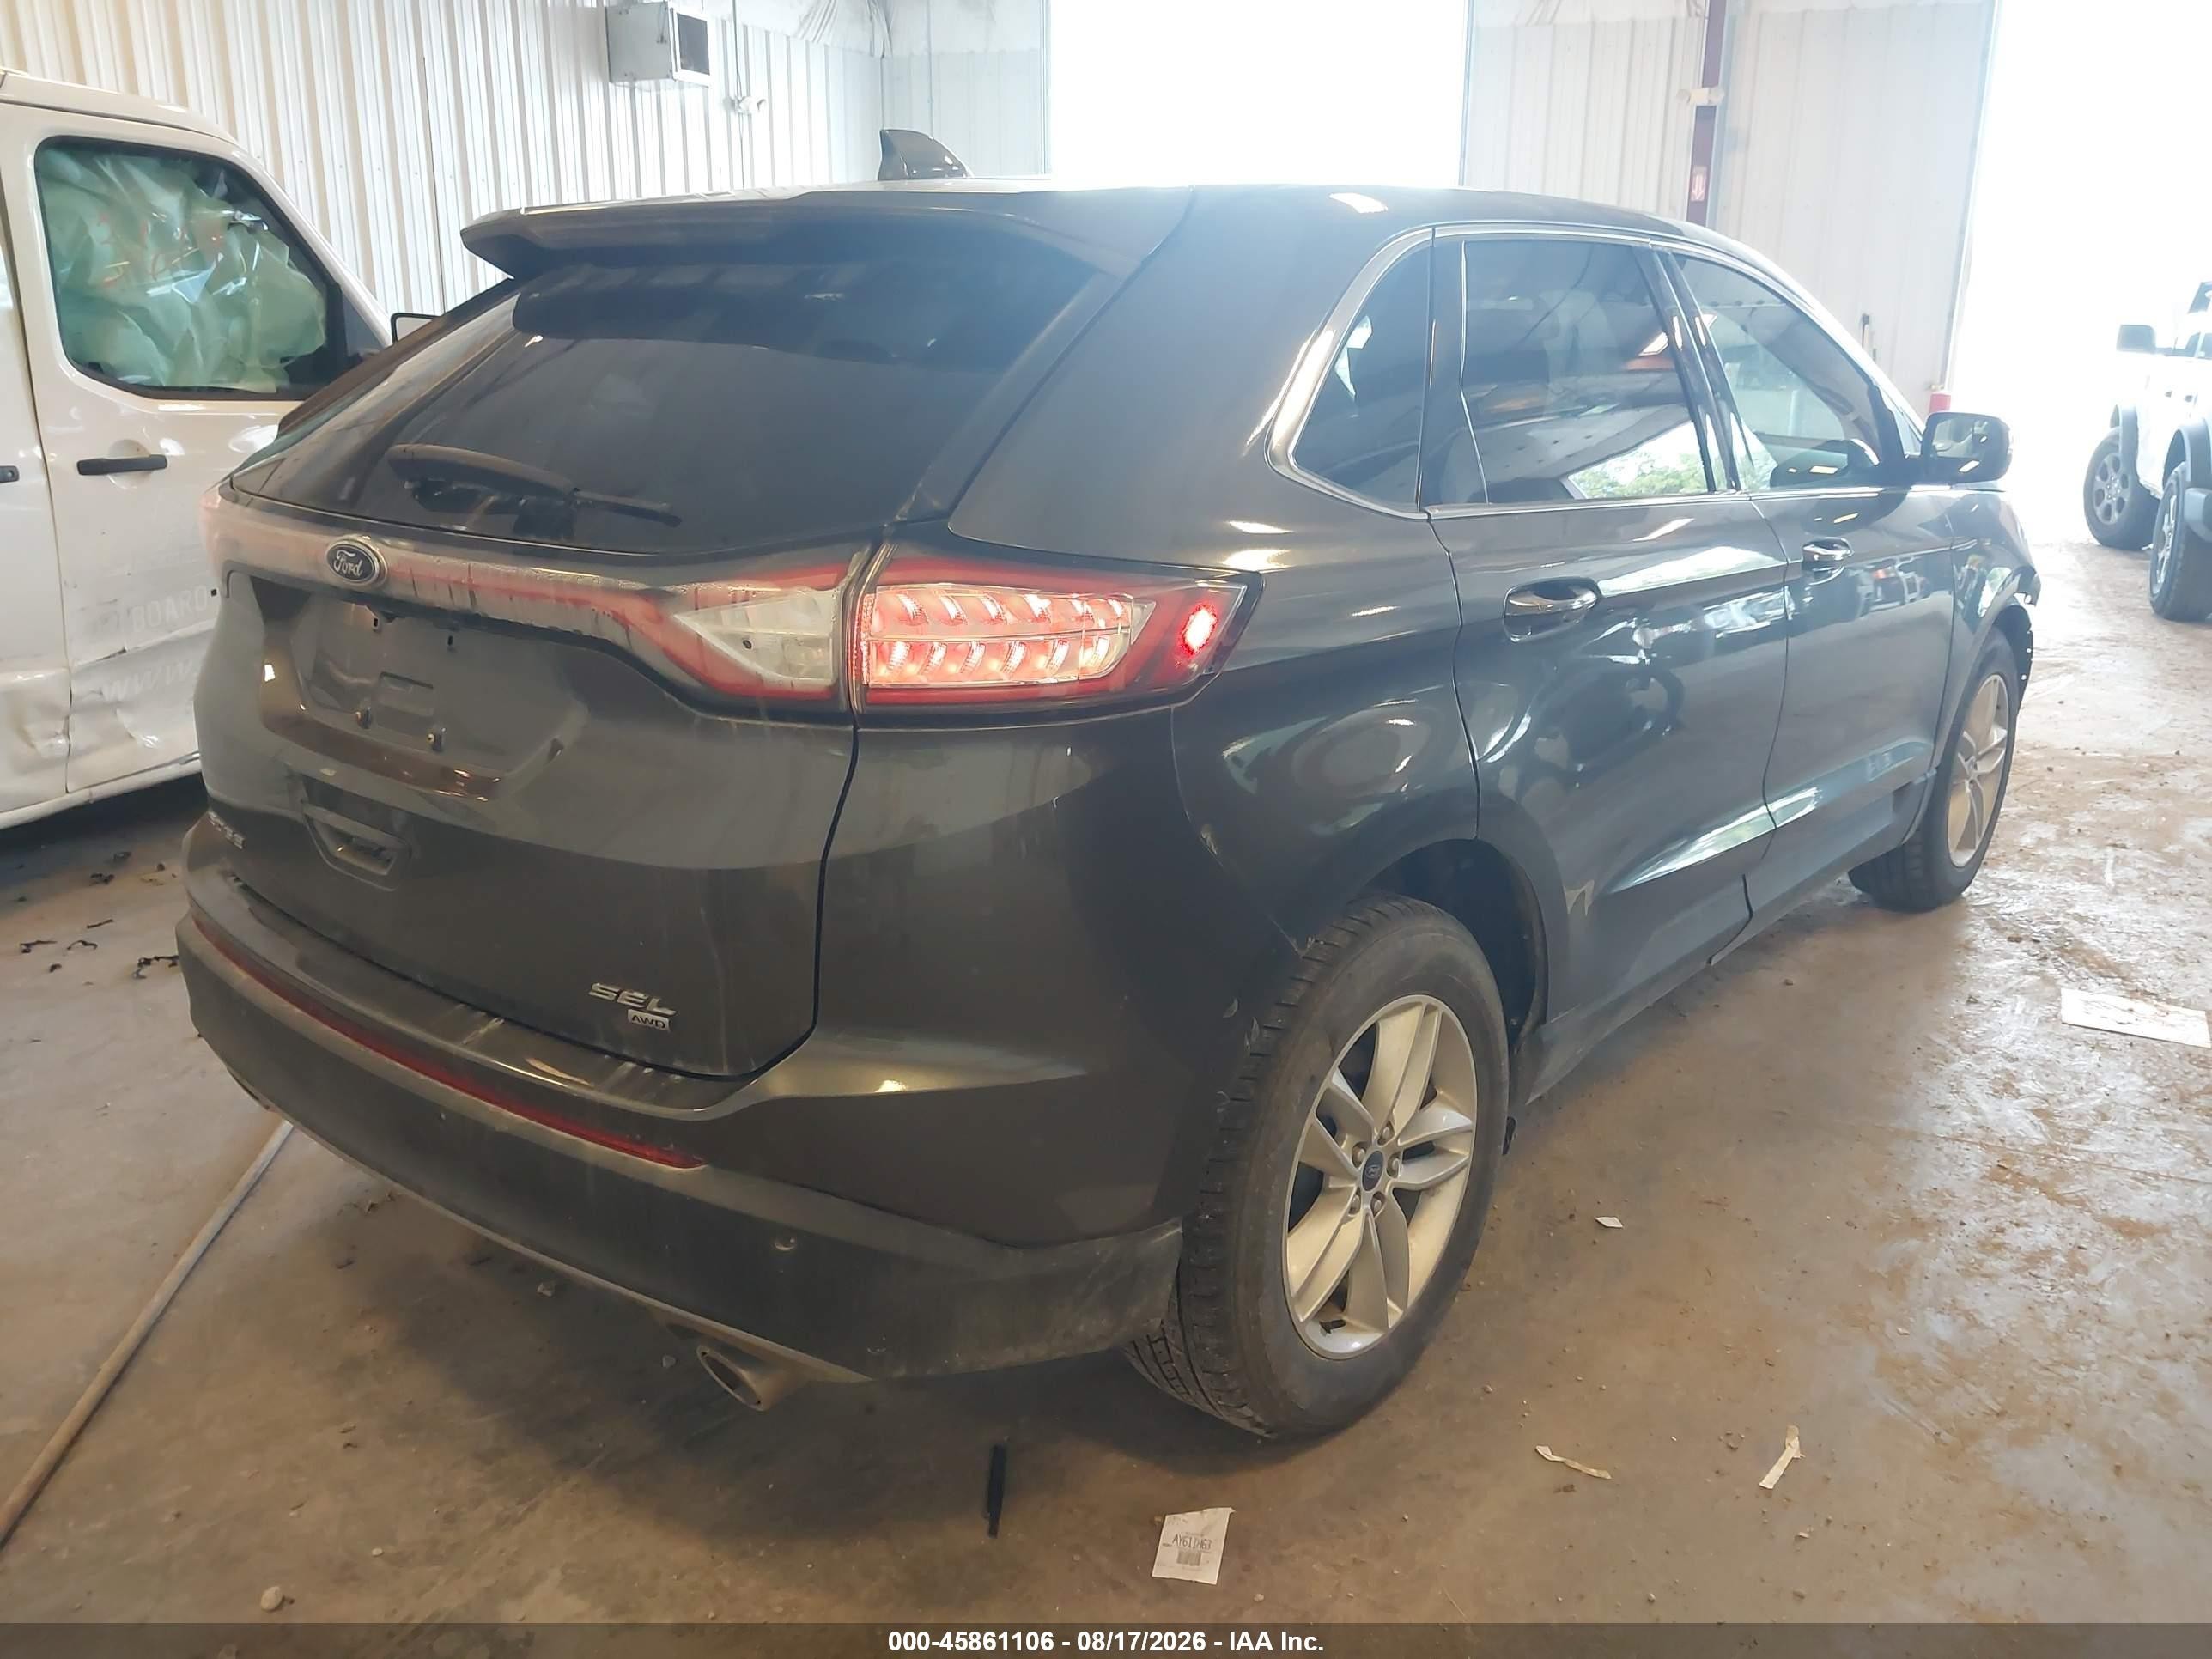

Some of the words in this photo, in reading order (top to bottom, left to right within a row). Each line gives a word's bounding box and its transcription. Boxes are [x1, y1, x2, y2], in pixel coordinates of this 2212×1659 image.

[333, 549, 363, 577] Ford
[588, 982, 677, 1016] SEL
[631, 1015, 666, 1029] AWD
